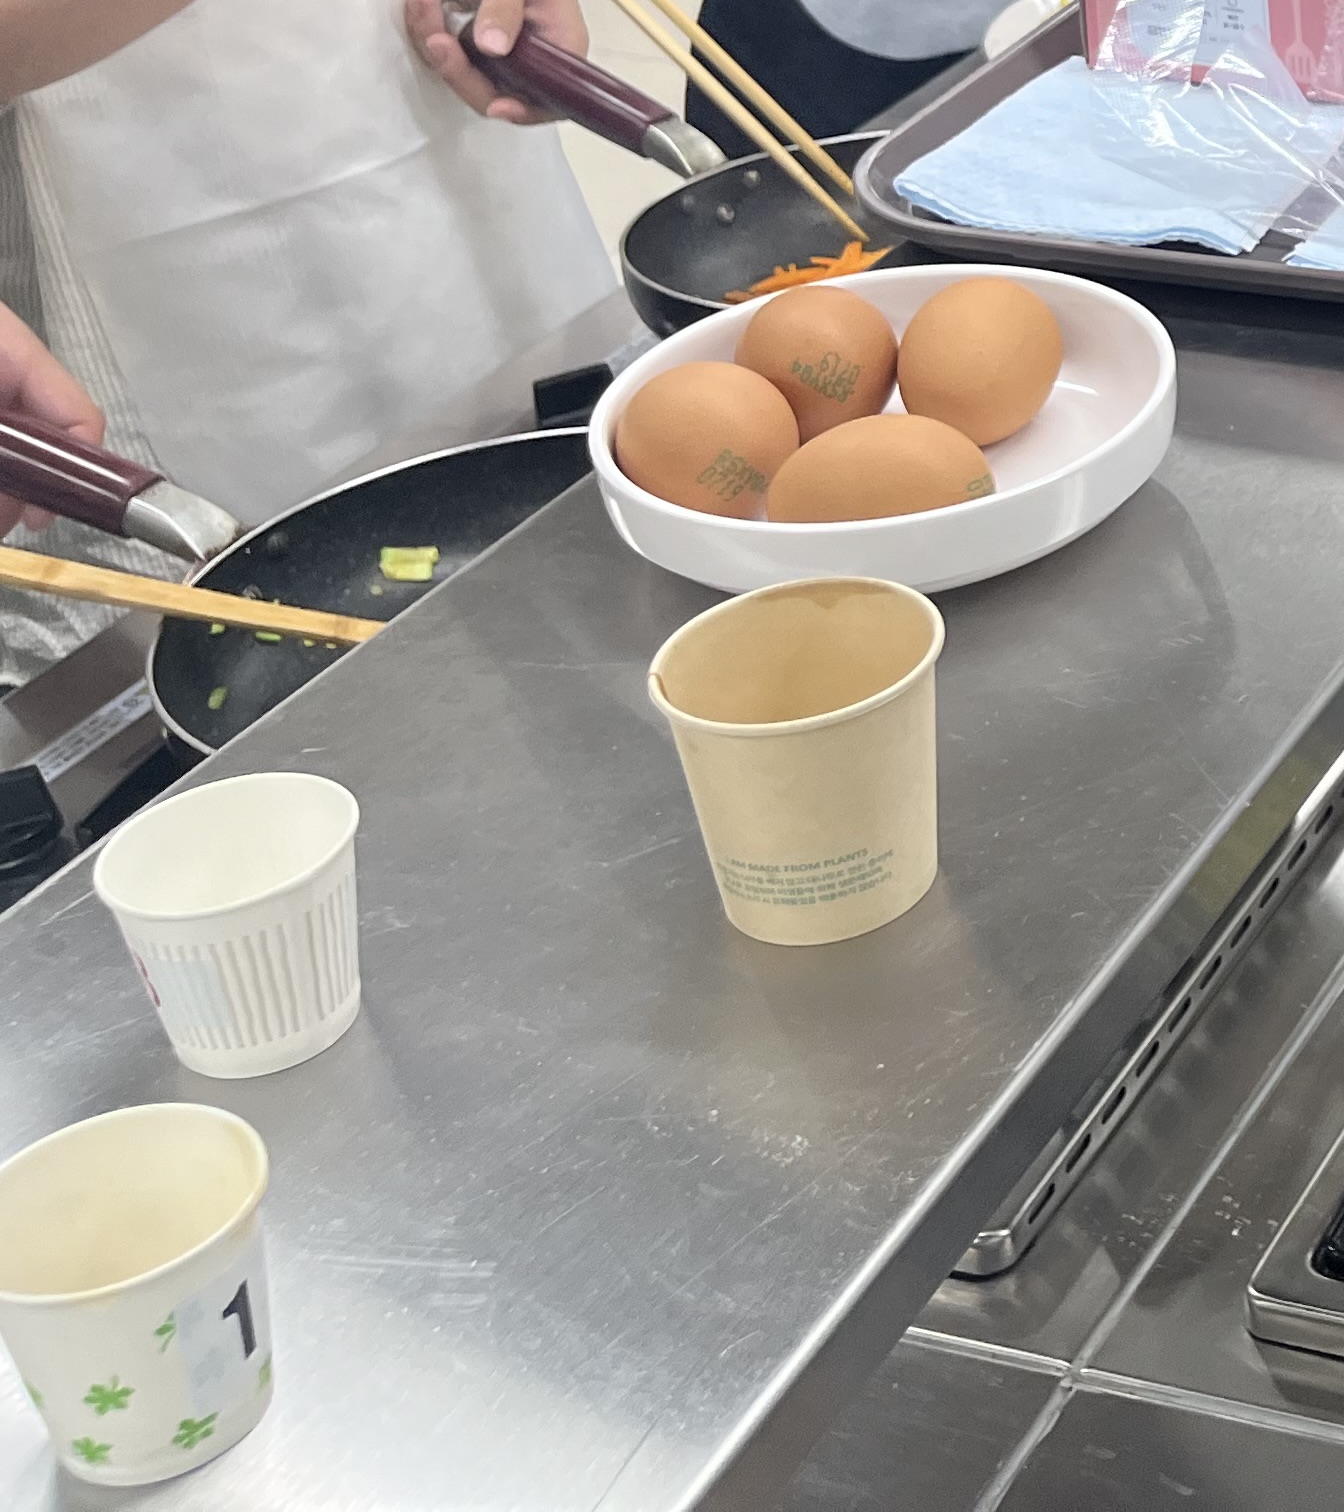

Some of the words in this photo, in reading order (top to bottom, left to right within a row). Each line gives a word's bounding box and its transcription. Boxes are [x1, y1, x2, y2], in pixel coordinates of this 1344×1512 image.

[748, 863, 782, 873] MADE
[783, 861, 821, 873] FROM
[823, 847, 868, 868] PLANTS
[221, 1278, 258, 1360] 1
